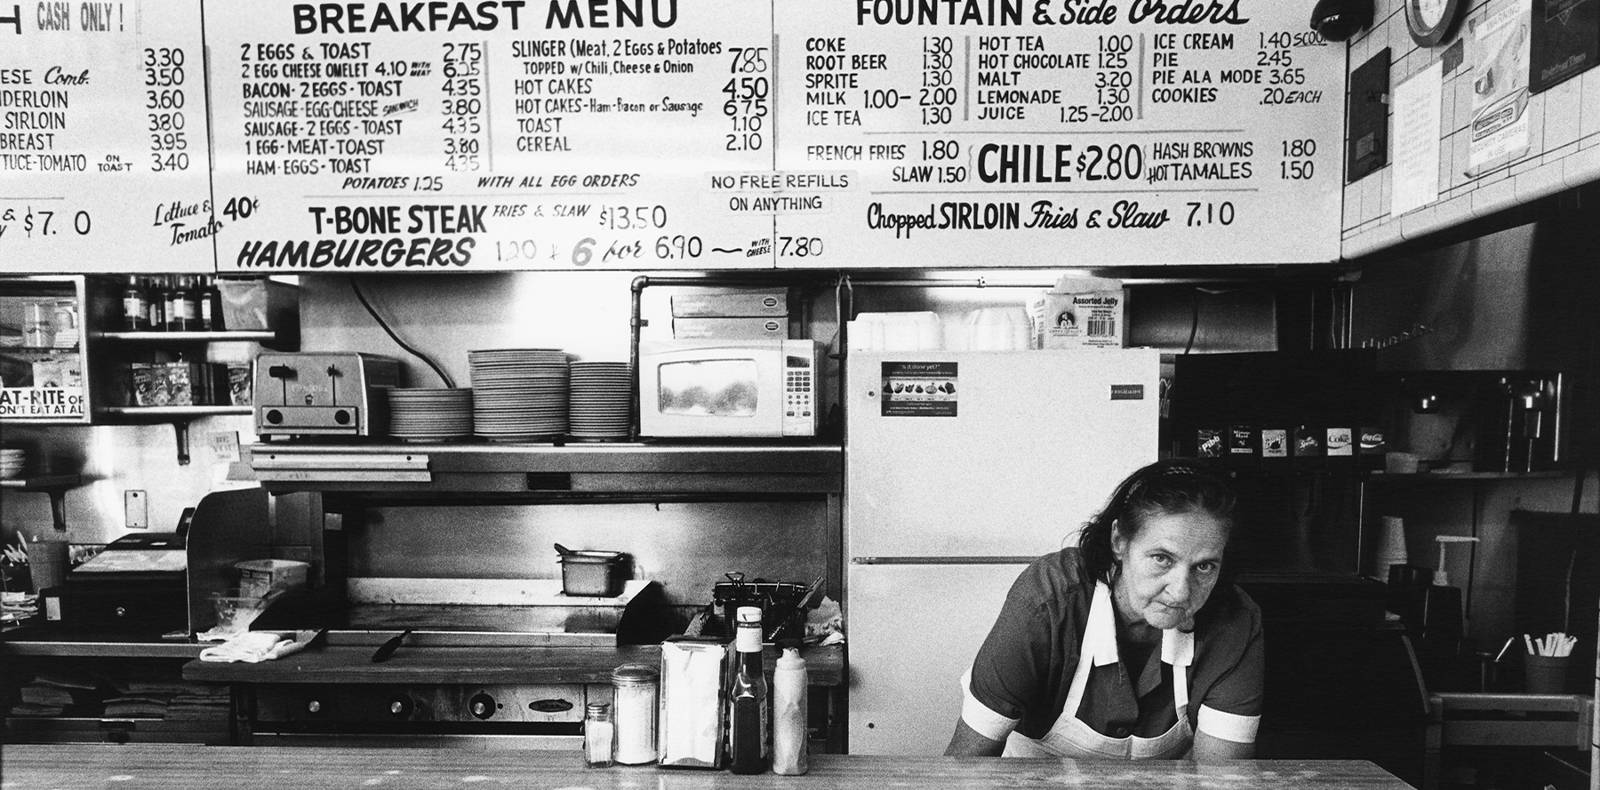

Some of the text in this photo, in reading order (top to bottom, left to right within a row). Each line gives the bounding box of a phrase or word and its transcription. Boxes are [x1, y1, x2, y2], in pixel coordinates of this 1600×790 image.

[37, 2, 70, 31] CASH
[293, 0, 678, 35] BREAKFAST MENU
[857, 0, 1250, 26] FOUNTAIN & Side Orders
[512, 38, 723, 57] SLINGER & Potatoes
[806, 37, 953, 54] COKE 1.30
[979, 35, 1133, 53] HOT TEA 1.00
[1153, 30, 1327, 50] ICE CREAM 1.40 SCOO
[144, 48, 185, 67] 3.30
[257, 42, 482, 62] EGGS & TOAST 2.75
[523, 47, 769, 75] TOPPED Cheese Onion 7.85
[978, 53, 1128, 70] HOT CHOCOLATE 1.25
[1153, 50, 1293, 67] PIE 2.45
[254, 60, 407, 78] EGG CHEESE OMELET 4.10
[411, 61, 432, 69] WITH
[806, 53, 953, 71] ROOT BEER 1.30
[44, 66, 90, 86] Comb.
[145, 67, 185, 86] 3.50
[410, 69, 432, 77] MEAT
[805, 70, 953, 89] SPRITE 1.30
[978, 71, 1132, 89] MALT 3.20
[1152, 67, 1305, 85] PIE ALA MODE 3.65
[357, 78, 481, 97] TOAST 4.35
[515, 77, 769, 100] HOT CAKES 4.50
[806, 87, 957, 106] MILK 2.00
[978, 88, 1130, 105] LEMONADE 1.30
[1151, 87, 1322, 105] COOKIES .20 EACH
[0, 89, 185, 110] DERLOIN 3.60
[382, 98, 419, 115] SANDWICH
[441, 98, 481, 116] 3.80
[515, 96, 704, 117] HOT or Sausage
[5, 111, 185, 132] SIRLOIN 3.80
[807, 107, 952, 126] ICE TEA 1.30
[978, 105, 1025, 121] JUICE
[319, 115, 481, 136] EGGS TOAST 4.35
[517, 116, 763, 134] TOAST 1.10
[0, 132, 188, 151] BREAST 3.95
[443, 137, 480, 156] 3.80
[516, 133, 763, 152] CEREAL 2.10
[807, 140, 960, 161] FRENCH FRIES 1.80
[1153, 138, 1317, 160] HASH BROWNS 1.80
[0, 154, 88, 172] TUCE-TOMATO
[97, 153, 190, 172] TOAST 3.40
[106, 154, 120, 163] ON
[977, 143, 1143, 184] CHILE $2.80
[477, 174, 641, 188] WITH ALL EGG ORDERS
[711, 174, 849, 190] NO FREE REFILLS
[892, 165, 967, 183] SLAW 1.50
[1147, 160, 1315, 185] HOT TAMALES 1.50
[342, 176, 444, 192] POTATOES 1.25
[729, 196, 823, 211] ON ANYTHING
[153, 200, 199, 227] Lettuce
[308, 204, 488, 235] T-BONE STEAK
[492, 204, 667, 231] FRIES SLAW $13.50
[867, 200, 1235, 239] Chopped SIRLOIN Fries & Slaw 7.10
[170, 214, 224, 247] Tomato
[236, 237, 477, 268] HAMBURGERS
[571, 237, 597, 267] 6
[655, 235, 703, 260] 6.90
[746, 247, 772, 257] CHEESE
[750, 239, 771, 249] WITH
[779, 236, 824, 258] 7.80
[1073, 296, 1102, 305] Assorted
[1103, 297, 1119, 307] Jelly
[54, 405, 66, 414] AT
